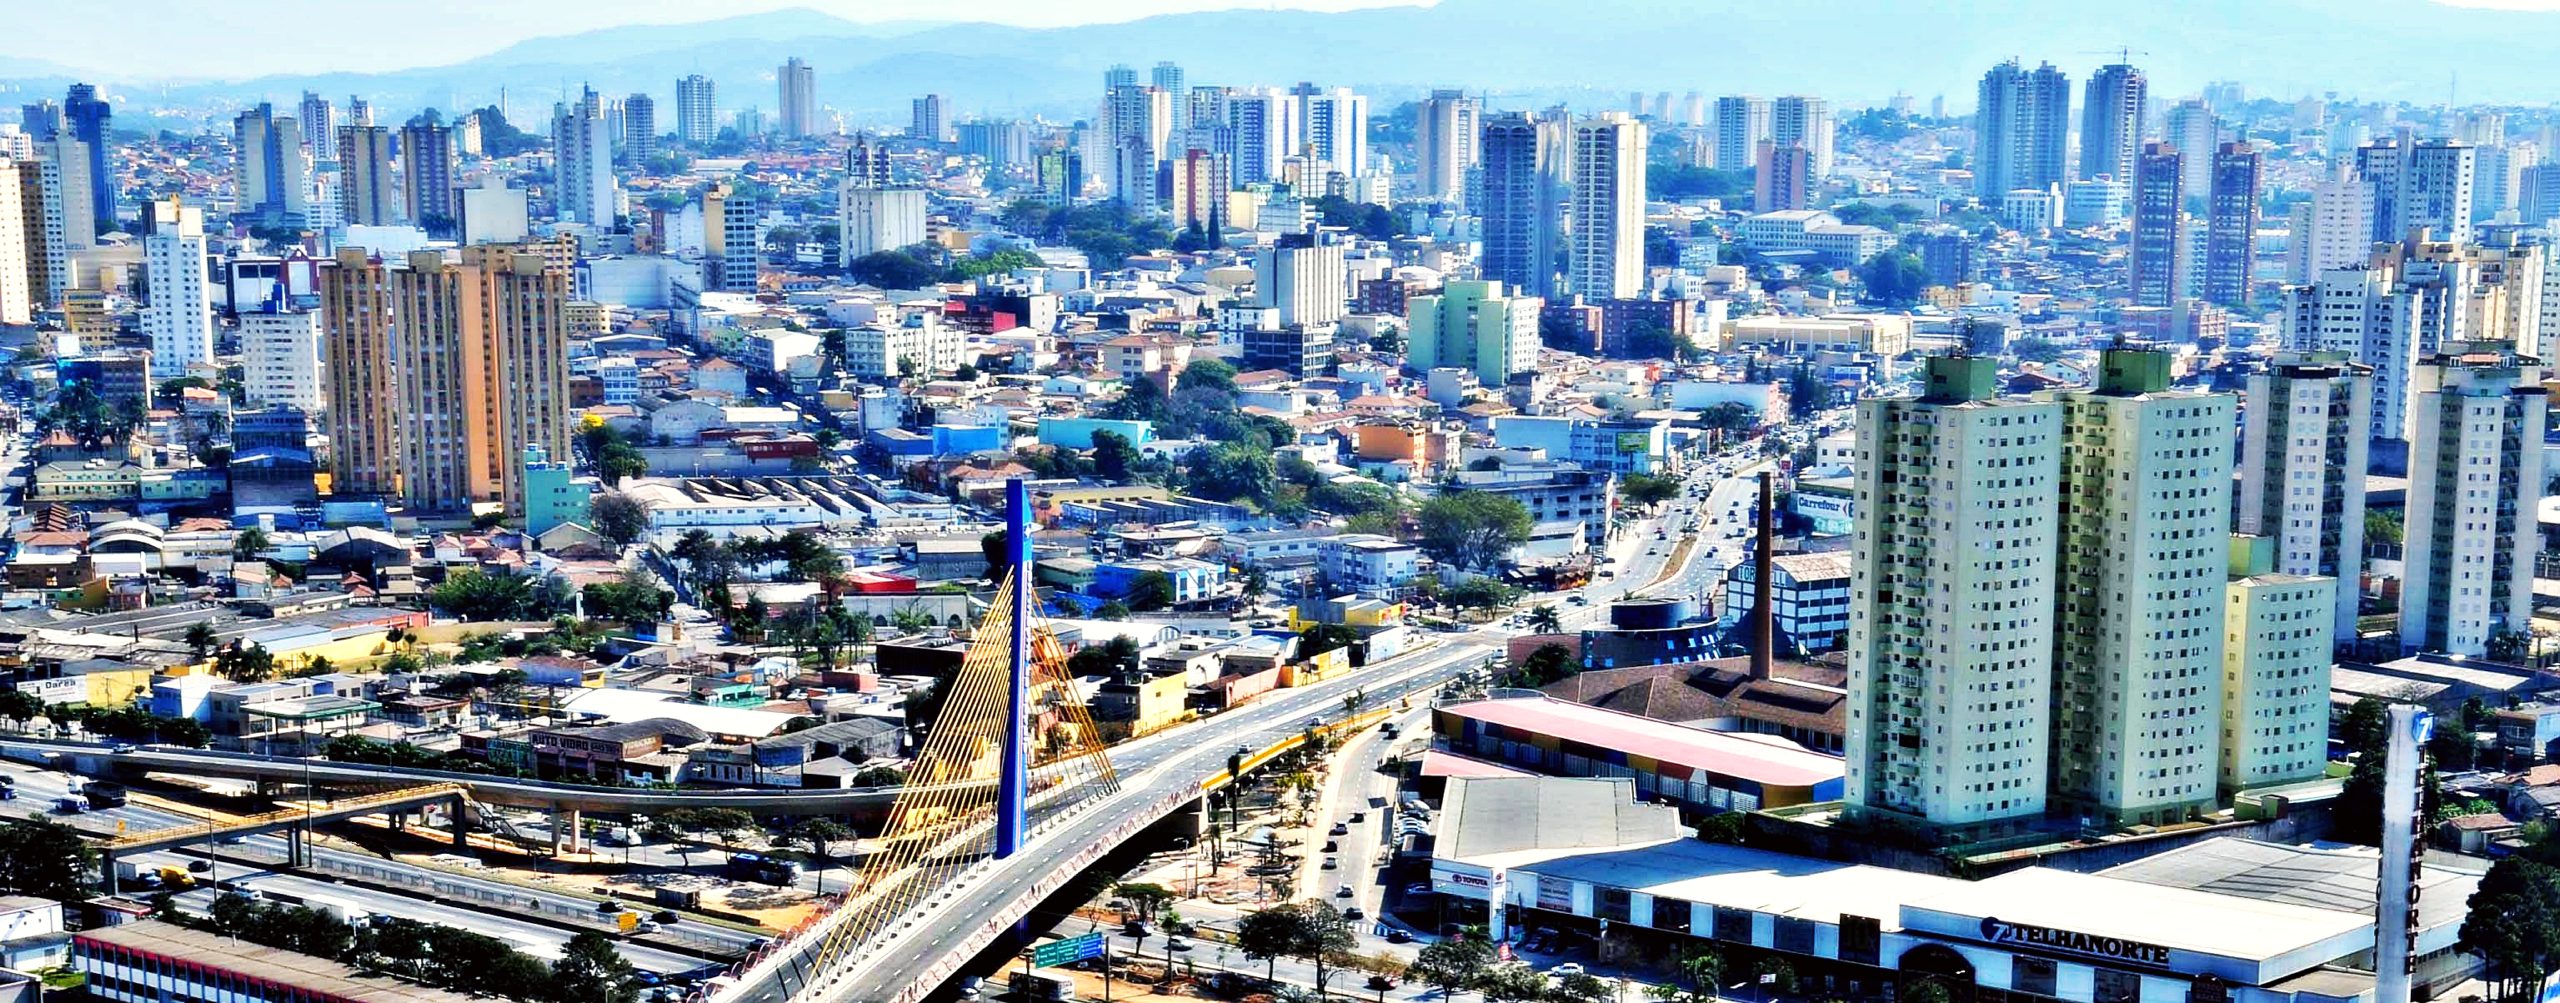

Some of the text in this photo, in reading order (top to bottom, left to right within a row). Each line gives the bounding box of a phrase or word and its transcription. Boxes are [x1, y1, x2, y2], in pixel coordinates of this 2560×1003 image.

[1799, 496, 1840, 512] Carrefour
[532, 734, 557, 747] AUTO
[560, 737, 588, 751] VIDRO
[1462, 876, 1488, 887] TOYOTA
[2012, 925, 2169, 961] TELHANORTE
